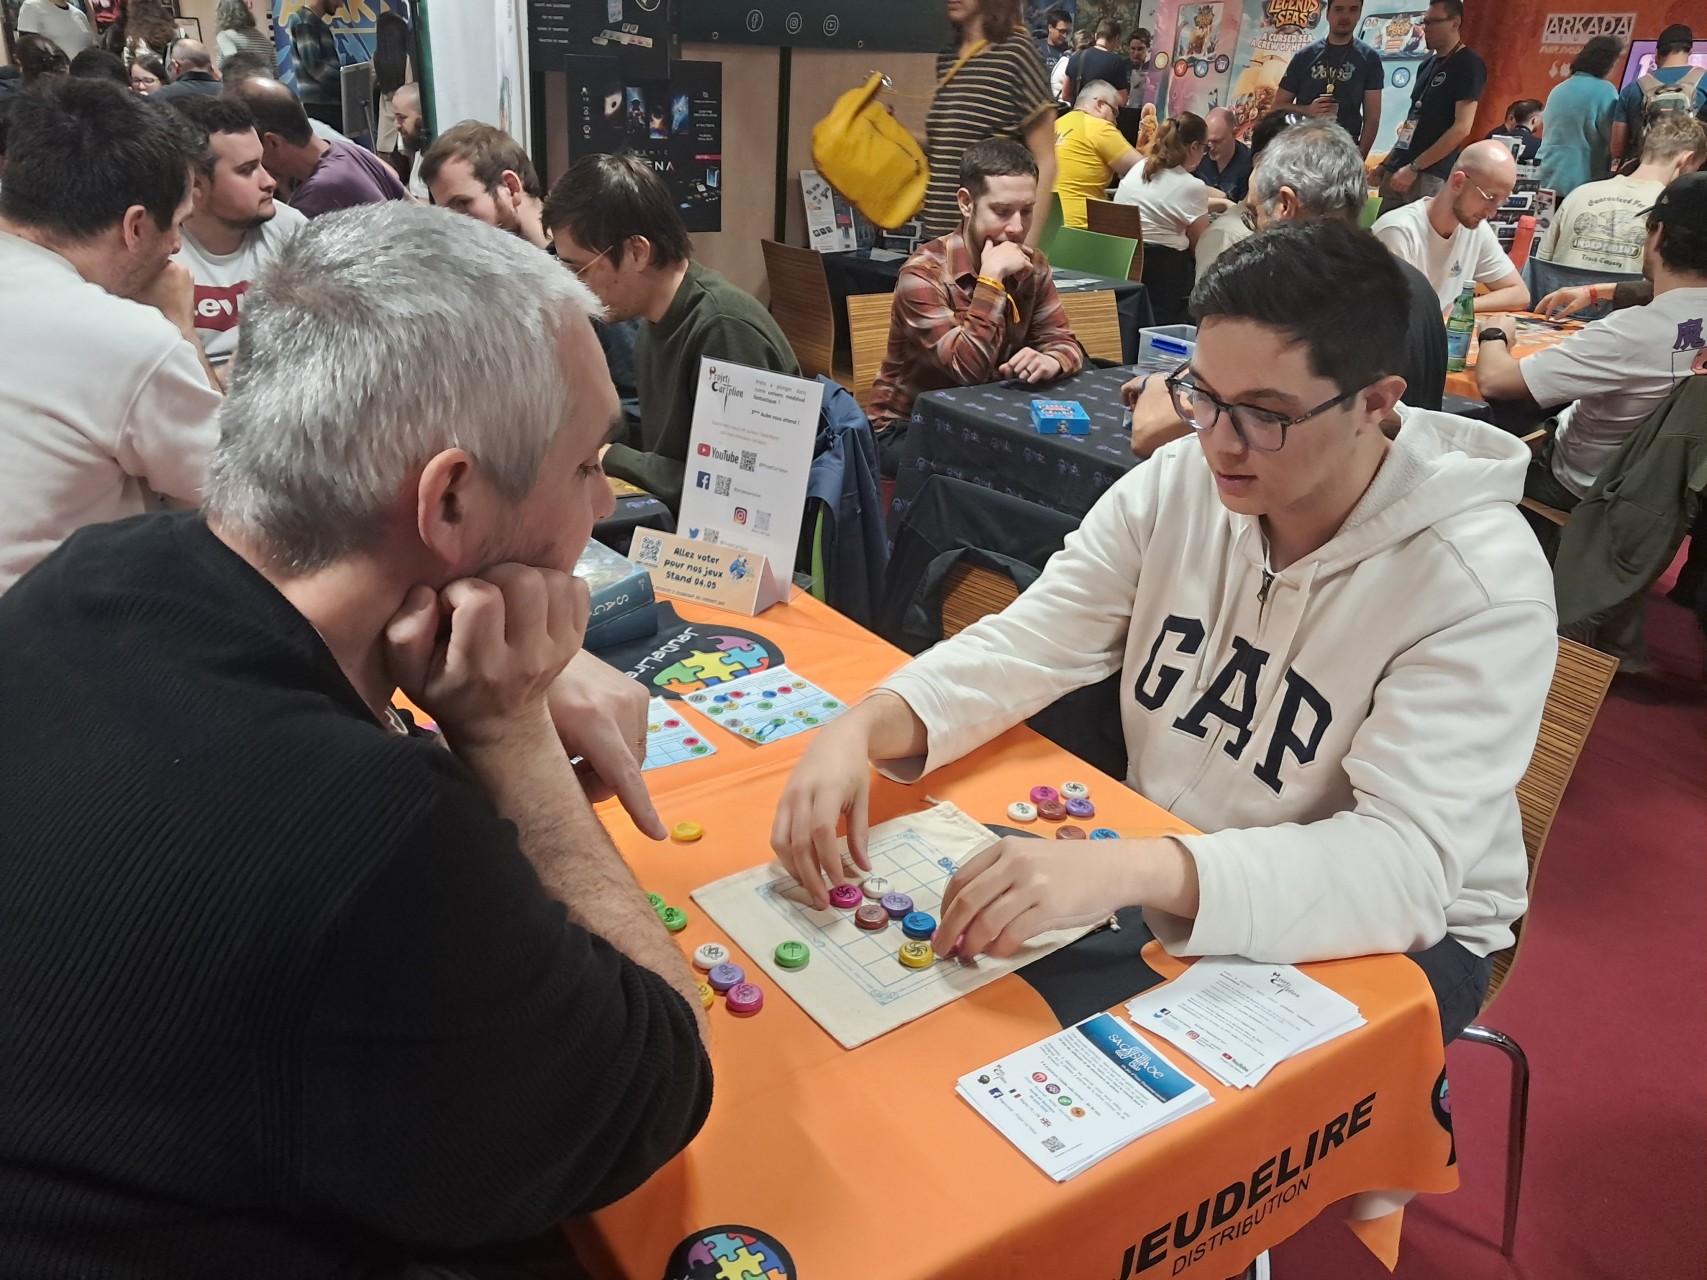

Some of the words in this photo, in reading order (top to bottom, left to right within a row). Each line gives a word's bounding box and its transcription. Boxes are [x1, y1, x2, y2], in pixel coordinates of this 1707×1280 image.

[1275, 10, 1309, 28] SEAS
[1545, 16, 1633, 35] ARKADA
[1258, 40, 1281, 51] CREW
[1268, 33, 1297, 43] CURSED
[1573, 237, 1640, 257] INDEPENDENT
[712, 446, 740, 465] YouTube
[673, 547, 695, 559] Allez
[697, 554, 720, 565] voter
[663, 559, 685, 570] pour
[687, 563, 703, 574] nos
[703, 564, 724, 578] jeux
[666, 570, 692, 584] Stand
[1134, 613, 1334, 796] GAP
[1111, 1091, 1377, 1280] JEUDELIRE
[1171, 1173, 1311, 1276] DISTRIBUTION
